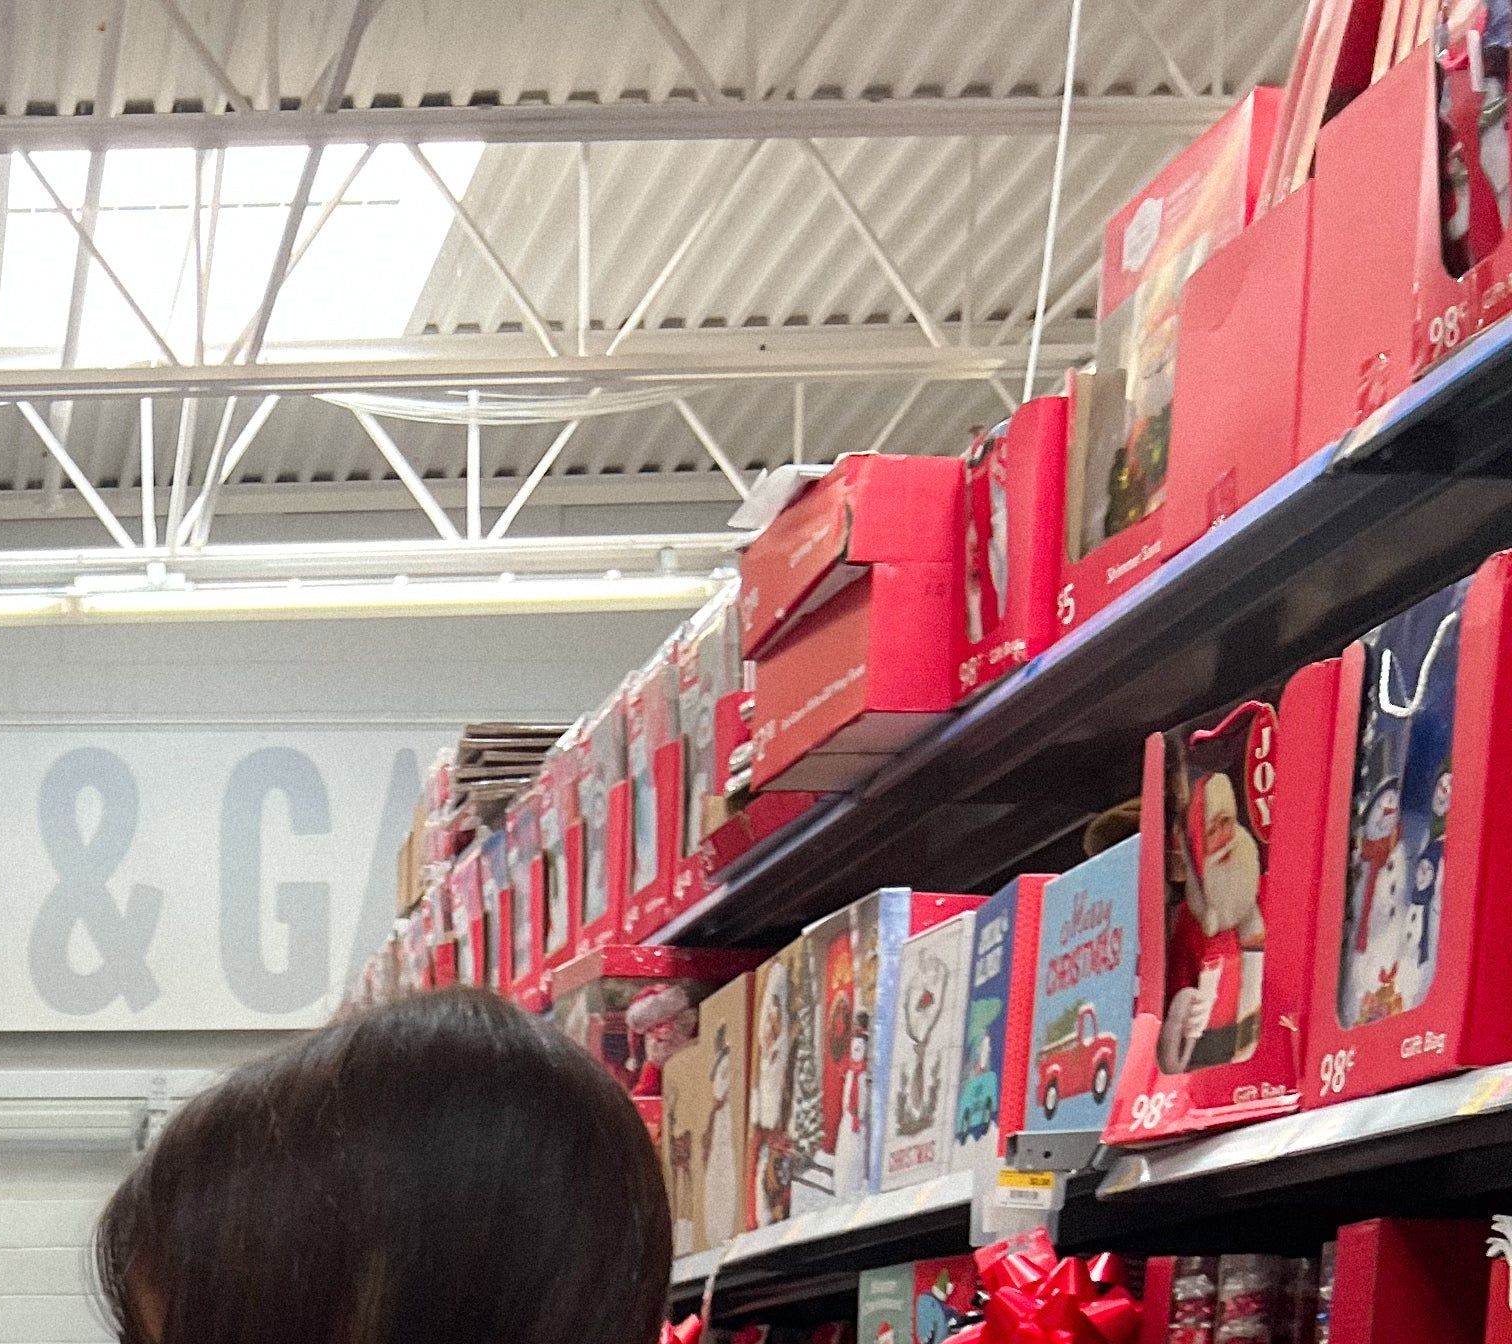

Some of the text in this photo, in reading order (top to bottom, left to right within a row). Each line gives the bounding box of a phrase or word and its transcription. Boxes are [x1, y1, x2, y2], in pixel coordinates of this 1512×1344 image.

[1252, 725, 1276, 829] JOY
[28, 747, 165, 1014] &
[1319, 1048, 1357, 1097] 98¢
[1128, 1092, 1178, 1133] 98¢
